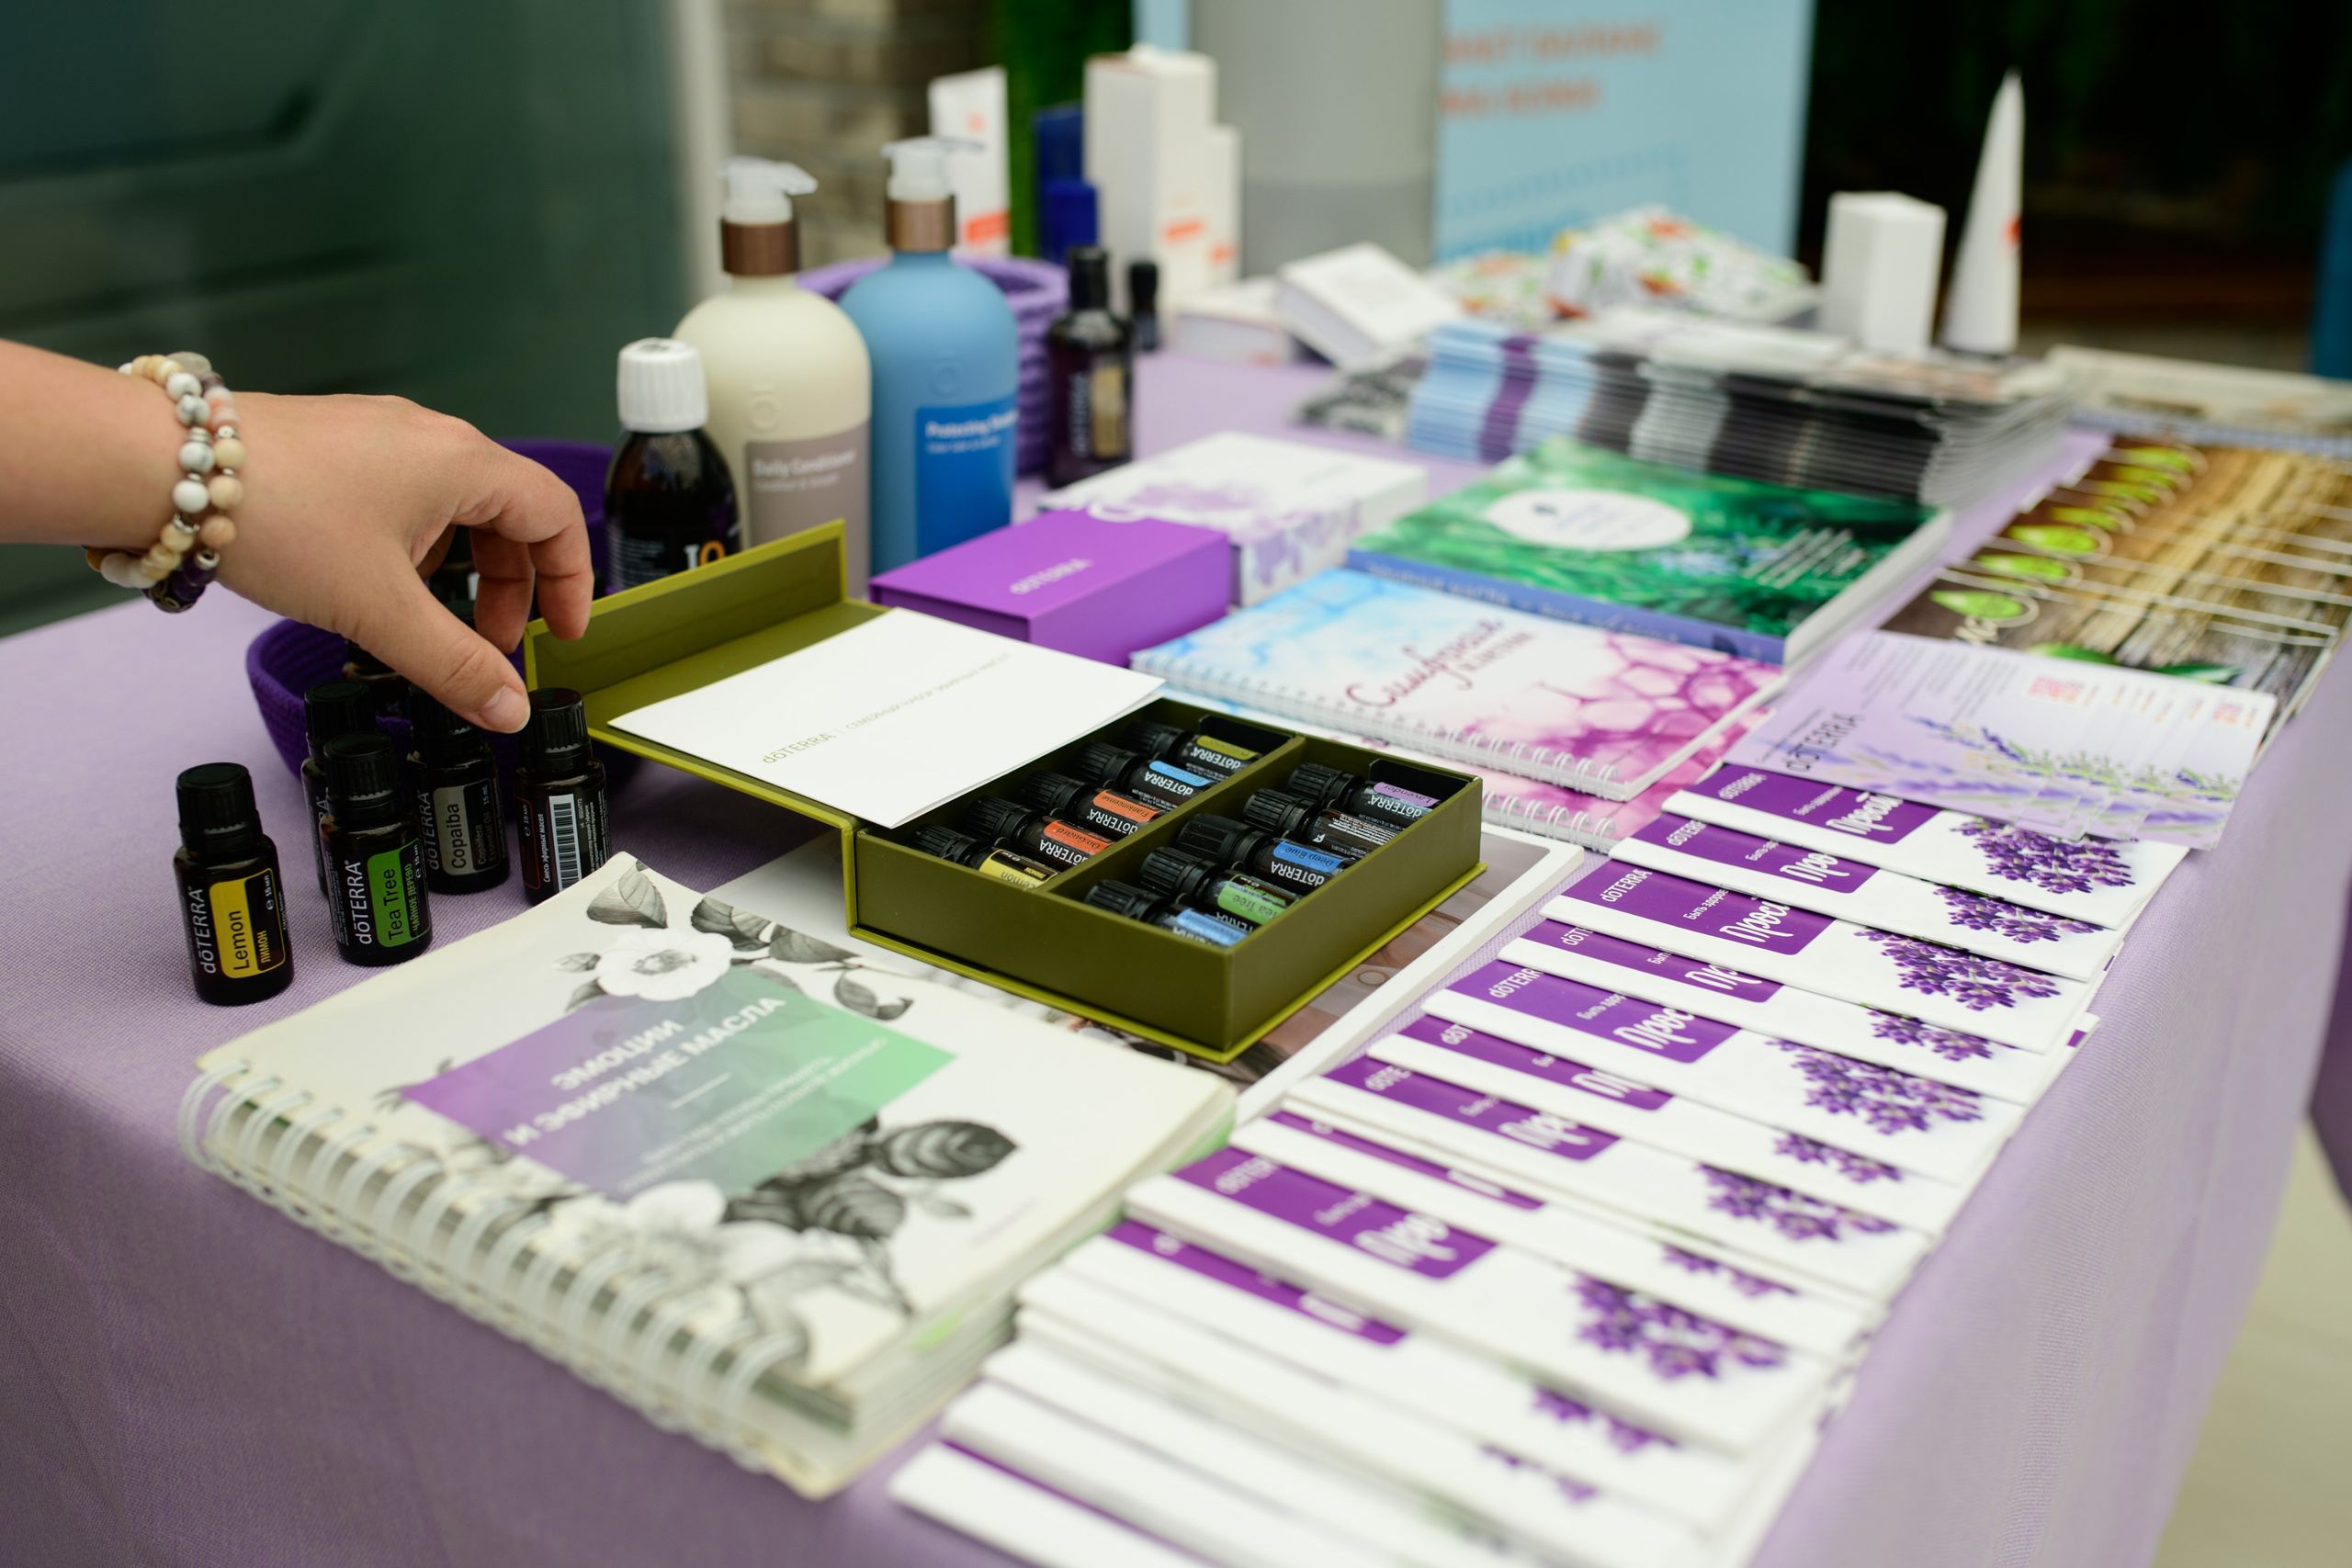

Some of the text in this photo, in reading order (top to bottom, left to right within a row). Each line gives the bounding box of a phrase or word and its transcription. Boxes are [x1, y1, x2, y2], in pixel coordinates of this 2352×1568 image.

[763, 731, 837, 764] dōTERRA
[1192, 746, 1241, 771] dōTERRA
[1144, 772, 1193, 796] dōTERRA
[1384, 784, 1431, 804] Lavender
[1102, 794, 1149, 818] Frankincense
[1370, 795, 1422, 818] dōTERRA
[417, 793, 440, 871] dōTERRA
[445, 803, 468, 869] Copaiba
[1057, 827, 1086, 845] Guard
[1087, 839, 1101, 850] On
[414, 856, 420, 865] 15
[540, 834, 549, 863] эфирных
[1285, 847, 1334, 867] Deep Blue
[264, 874, 273, 897] 15 мл
[1271, 862, 1325, 887] dōTERRA
[1600, 868, 1653, 903] dōTERRA
[345, 862, 373, 945] dōTERRA
[383, 868, 404, 941] Tea Tree
[404, 863, 420, 931] ЧАЙНОЕ ДЕРЕВО
[1232, 895, 1258, 911] Tree
[1683, 904, 1708, 920] Быть
[187, 888, 217, 974] dōTERRA
[228, 910, 251, 971] Lemon
[256, 930, 271, 964] ЛИМОН
[551, 1020, 684, 1090] ЭМОЦИИ
[503, 998, 786, 1147] И ЭФИРНЫЕ МАСЛА
